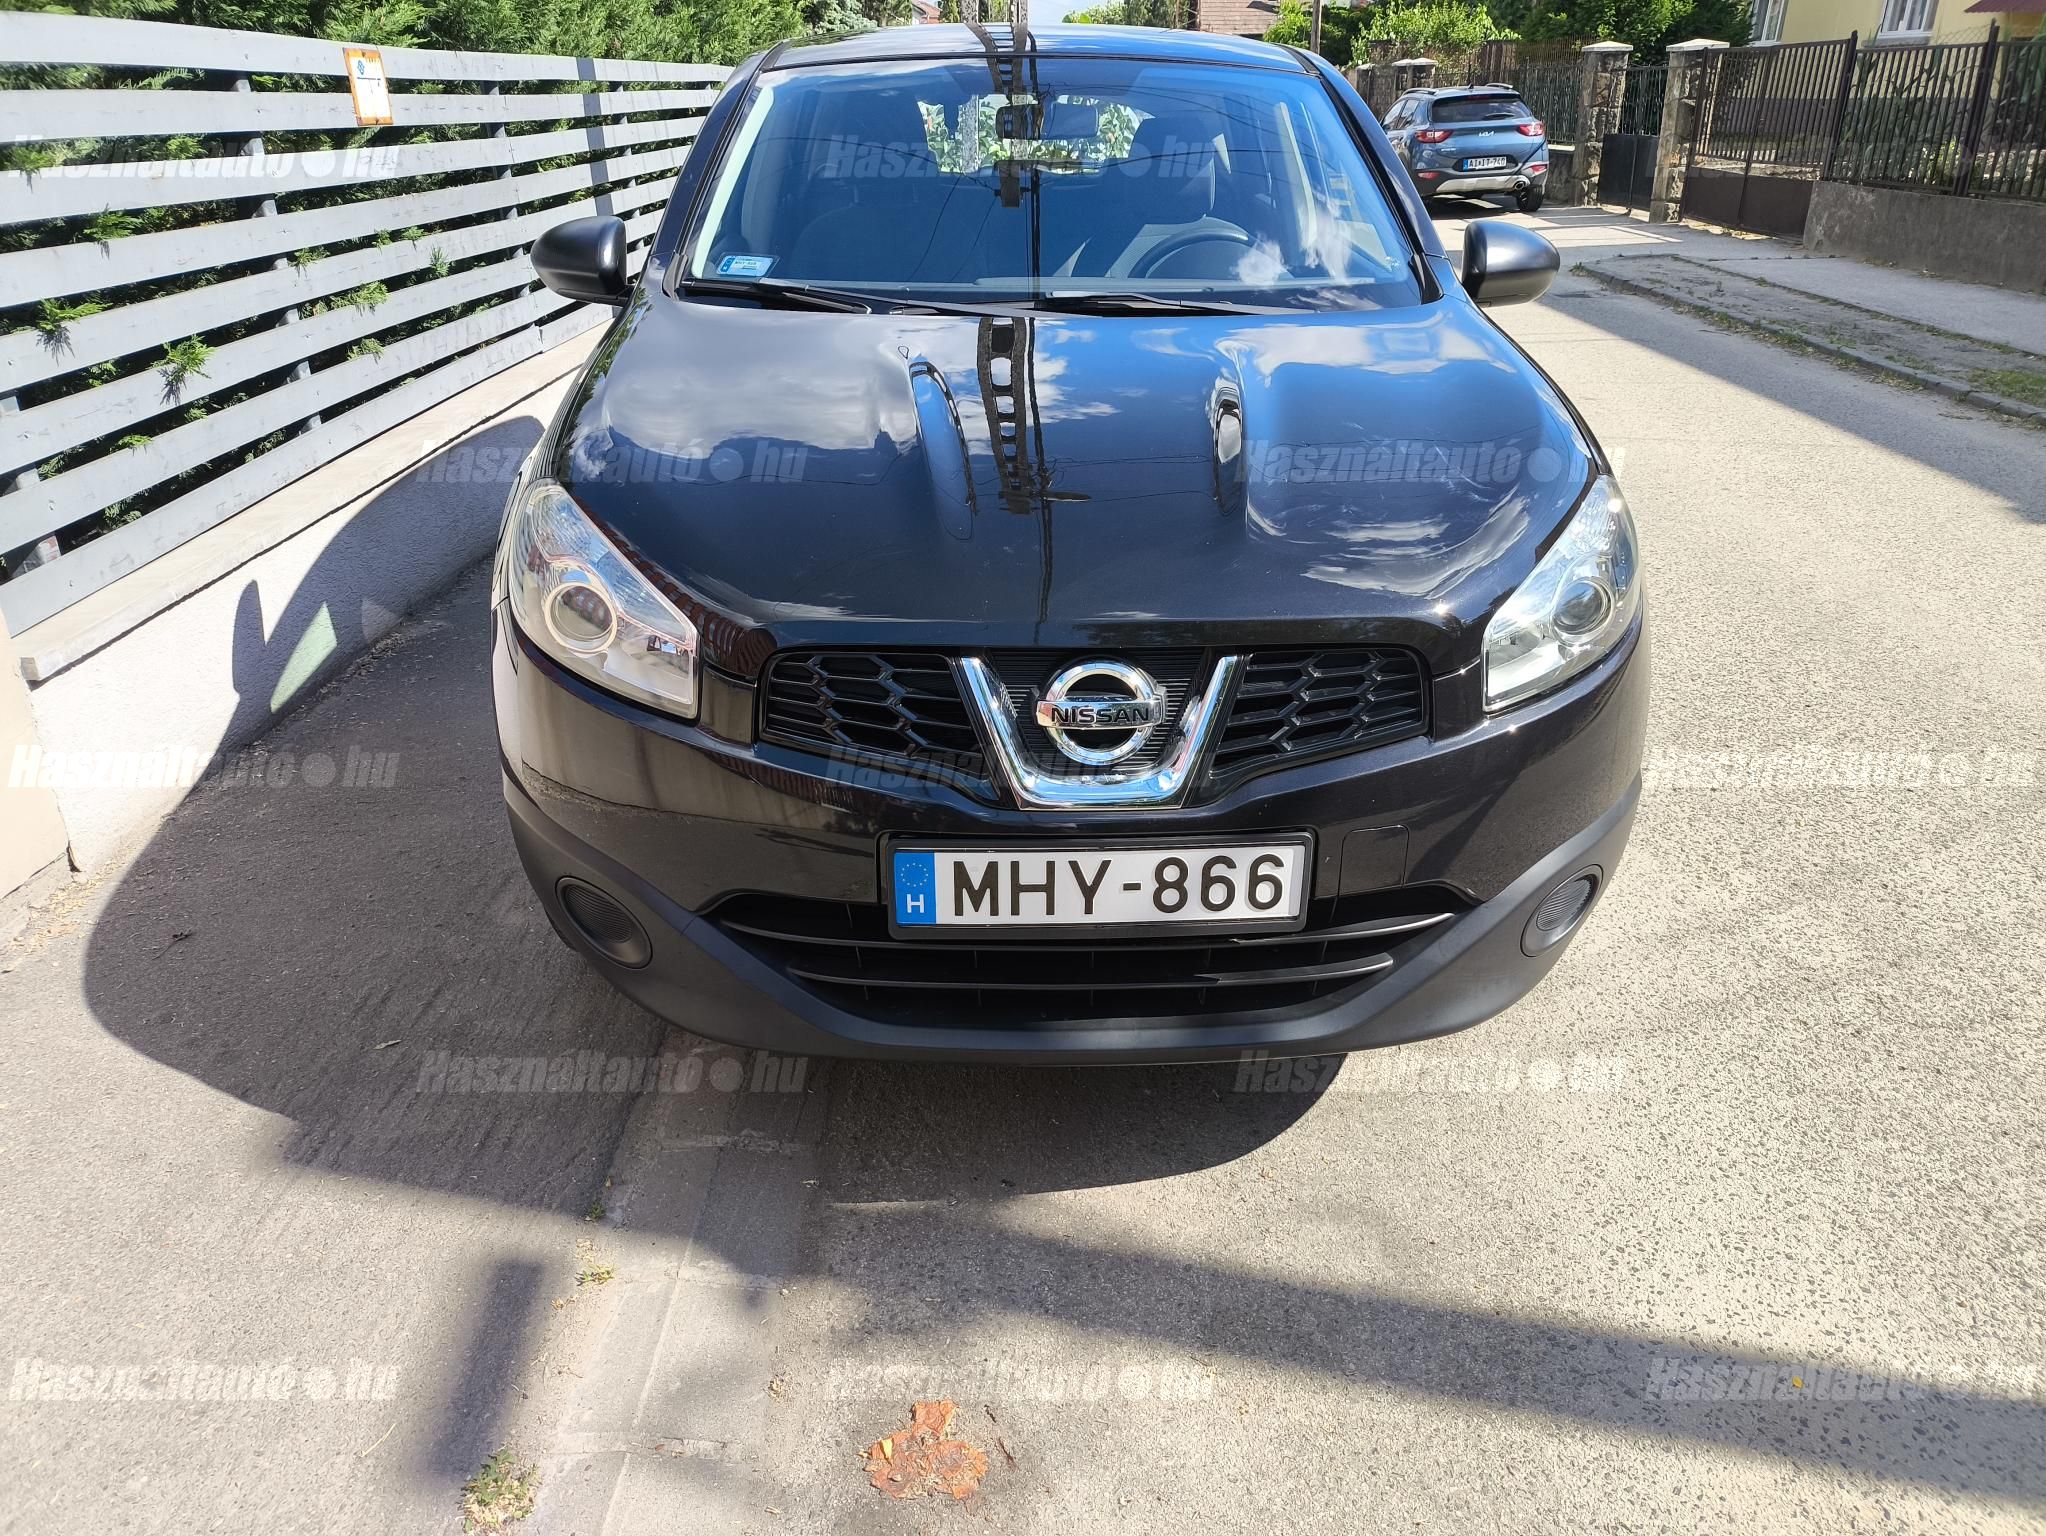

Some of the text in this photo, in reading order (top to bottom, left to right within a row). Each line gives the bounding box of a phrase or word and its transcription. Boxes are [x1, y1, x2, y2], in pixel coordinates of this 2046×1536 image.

[1051, 706, 1150, 724] NISSAN
[952, 853, 1285, 917] MHY-866
[906, 893, 924, 914] H
